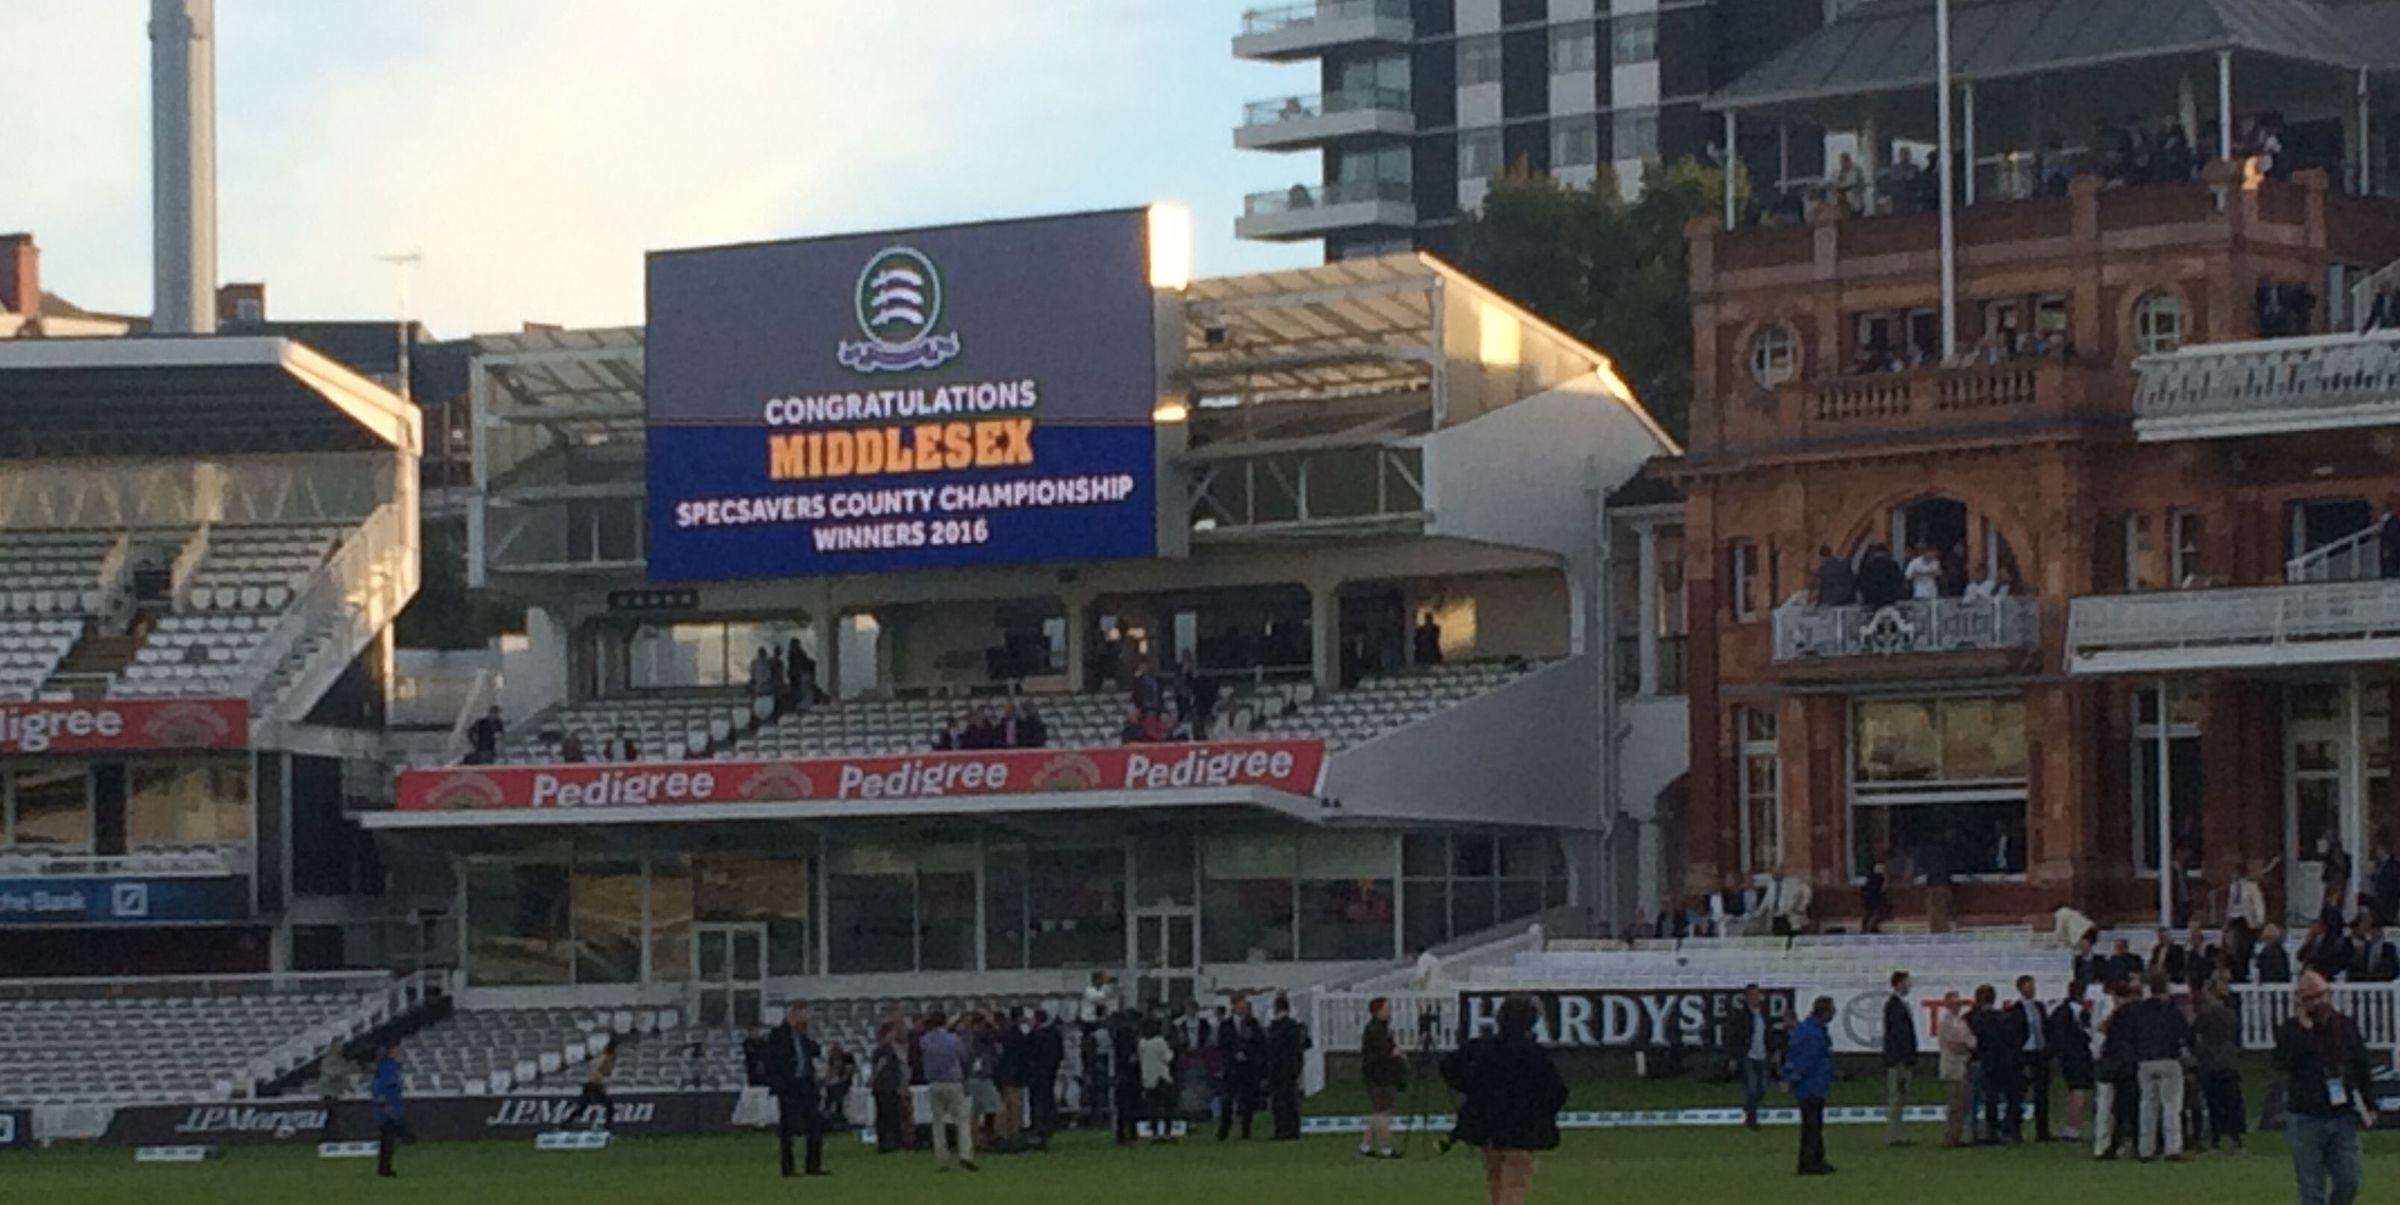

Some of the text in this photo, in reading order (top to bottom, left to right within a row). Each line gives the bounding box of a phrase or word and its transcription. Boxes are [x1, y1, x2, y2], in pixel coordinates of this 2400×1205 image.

[765, 380, 1037, 426] CONGRATULATIONS
[767, 418, 1034, 480] MIDDLESEX
[675, 475, 1134, 528] SPECSAVERS COUNTY CHAMPIONSHIP
[813, 518, 988, 552] WINNERS 2016
[532, 771, 715, 808] Pedigree
[838, 760, 1008, 802] Pedigree
[1125, 749, 1294, 788] Pedigree
